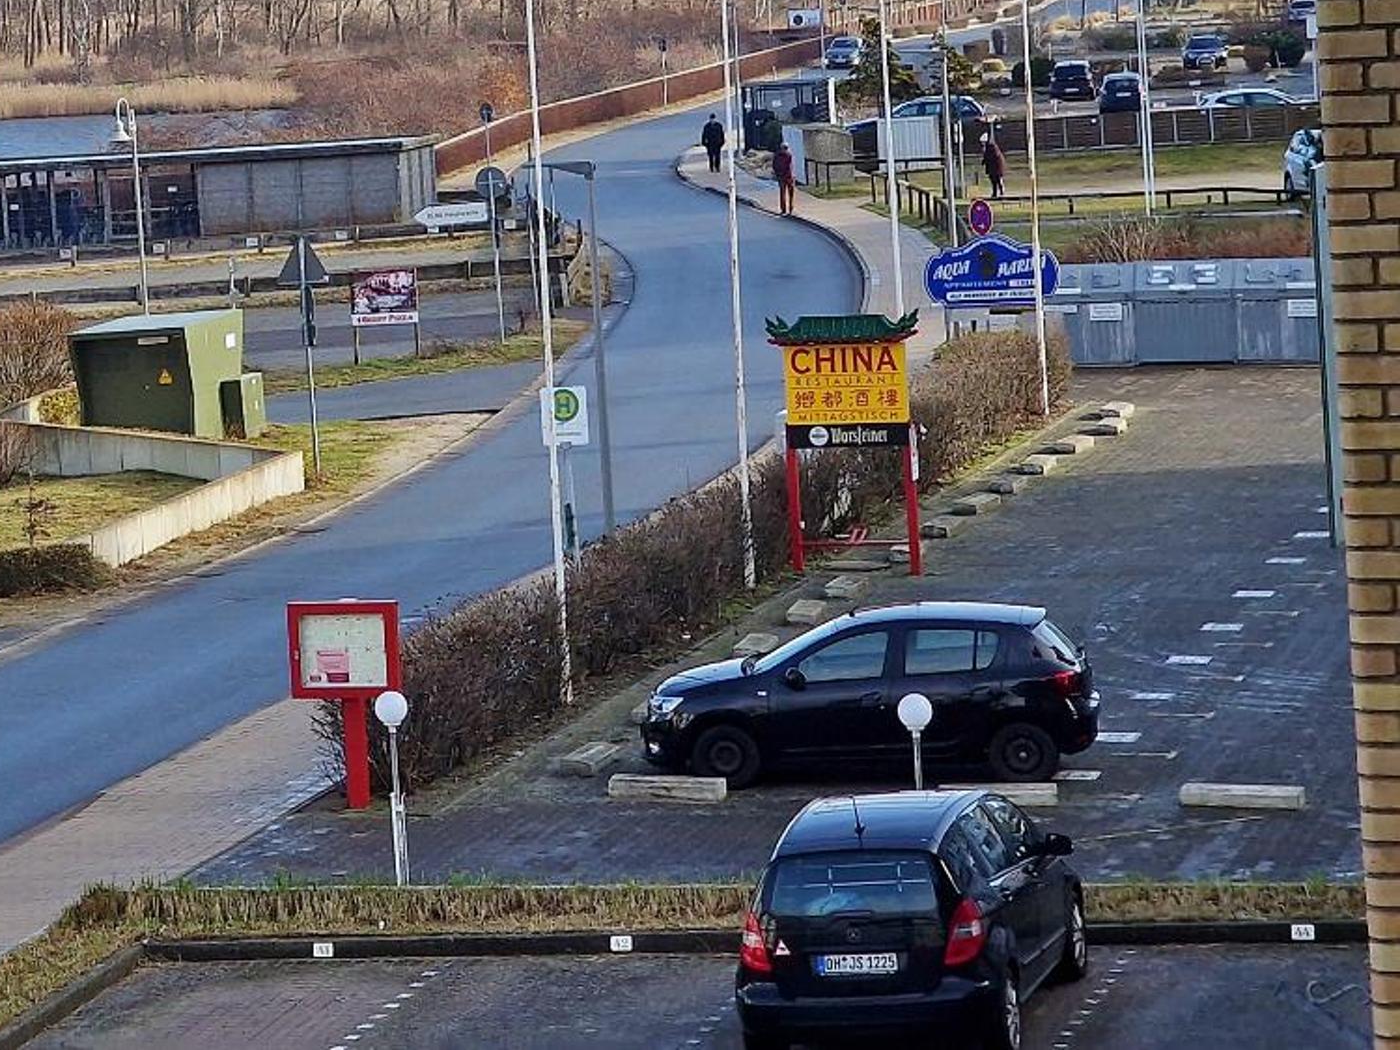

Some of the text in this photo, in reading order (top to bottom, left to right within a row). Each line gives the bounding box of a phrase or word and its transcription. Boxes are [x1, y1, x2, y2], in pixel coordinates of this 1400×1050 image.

[933, 260, 971, 281] AQUA
[790, 345, 898, 375] CHINA
[795, 375, 897, 386] RESTAURANT
[798, 411, 898, 423] MITTAGSTISCH
